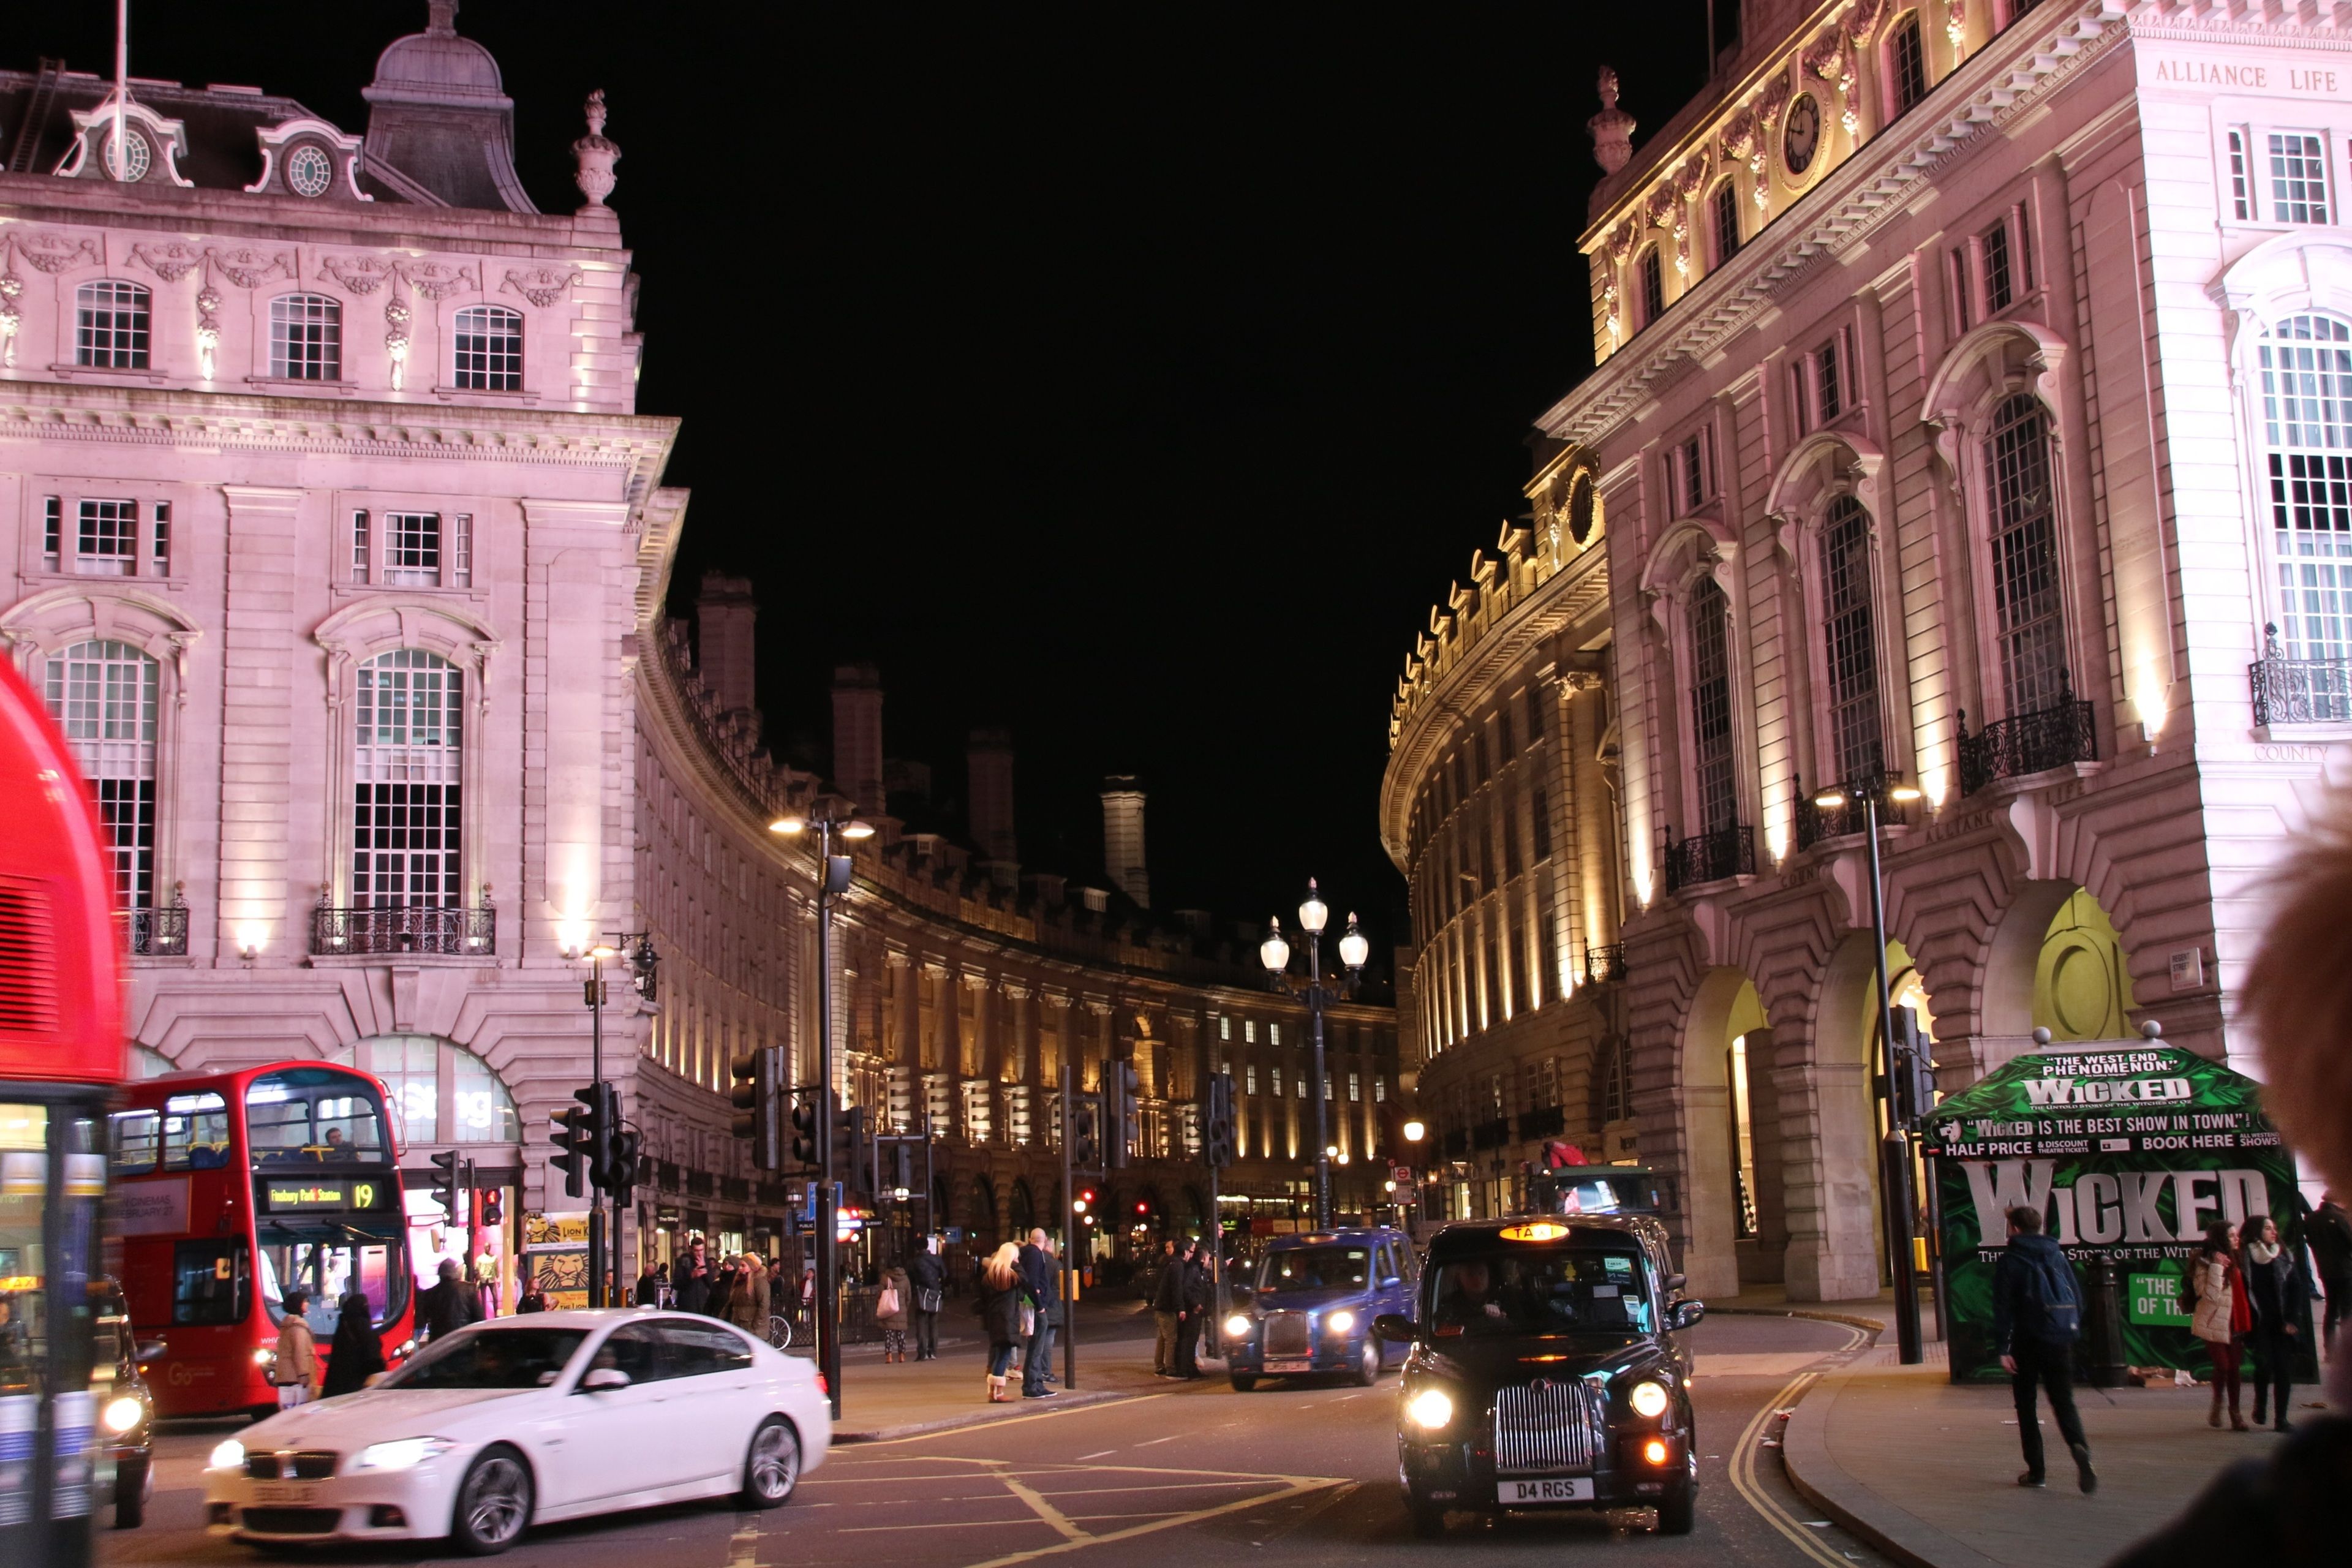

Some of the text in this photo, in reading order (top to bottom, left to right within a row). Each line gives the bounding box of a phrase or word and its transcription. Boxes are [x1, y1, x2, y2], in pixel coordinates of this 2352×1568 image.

[2155, 60, 2339, 92] ALLIANCE LIFE
[2254, 745, 2328, 762] COUNTY
[1781, 866, 1822, 888] COUN
[1926, 809, 1994, 843] ALLIANC
[2085, 1055, 2124, 1064] WEST
[2128, 1053, 2157, 1061] END
[2043, 1060, 2178, 1076] PHENOMENON.”
[2038, 1122, 2052, 1135] IS
[2056, 1119, 2083, 1134] THE
[2087, 1118, 2122, 1133] BEST
[2126, 1116, 2168, 1132] SHOW
[2173, 1115, 2188, 1130] IN
[2192, 1113, 2243, 1128] TOWN.”
[1946, 1142, 2032, 1156] HALF PRICE
[2046, 1140, 2089, 1148] DISCOUNT
[2142, 1134, 2234, 1150] BOOK HERE
[271, 1188, 341, 1205] Finsbury Park Station
[355, 1185, 373, 1208] 19
[1513, 1227, 1554, 1238] TAXI
[2114, 1249, 2132, 1259] OF
[2133, 1248, 2161, 1259] THE
[2138, 1297, 2158, 1314] OF
[1517, 1481, 1575, 1499] D4 RGS
